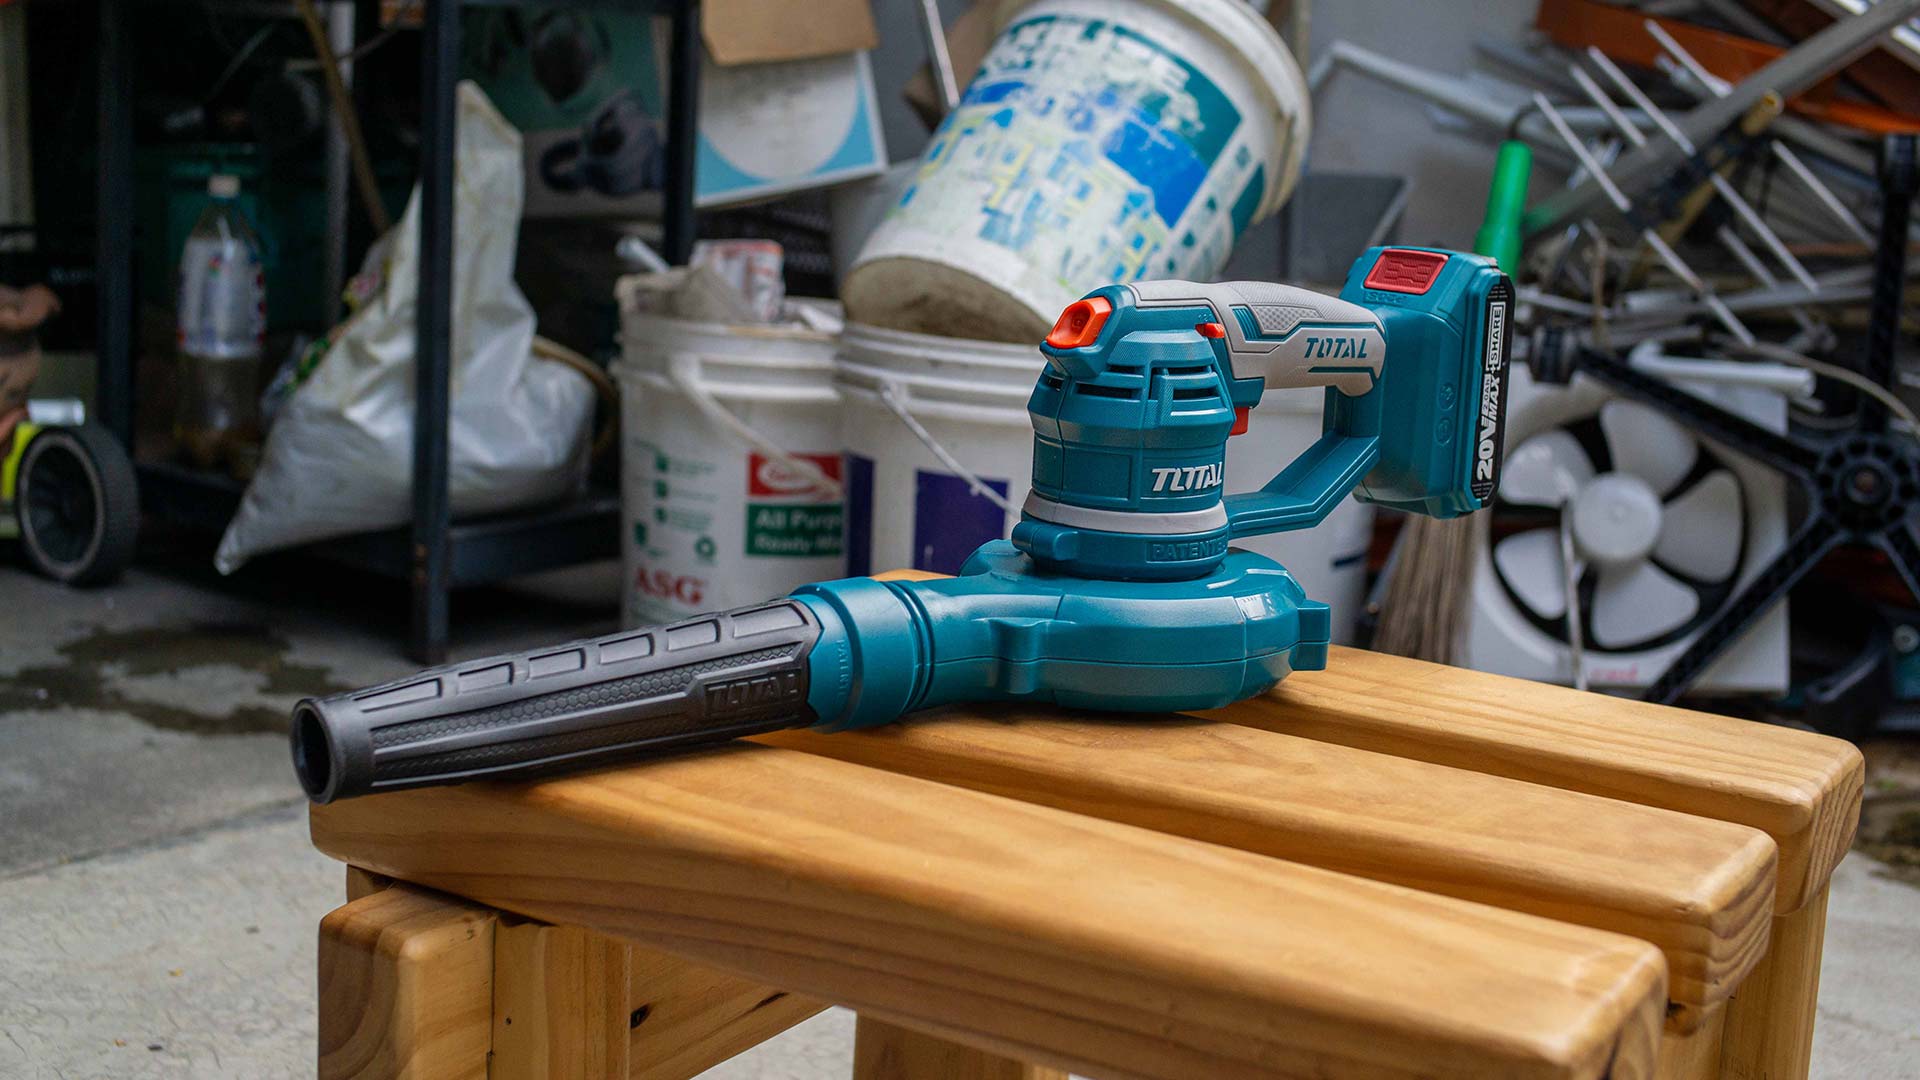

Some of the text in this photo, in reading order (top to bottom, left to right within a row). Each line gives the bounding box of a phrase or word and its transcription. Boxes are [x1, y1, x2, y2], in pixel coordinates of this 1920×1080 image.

[1304, 338, 1367, 358] TOTAL
[1477, 373, 1500, 480] 20V MAX
[1153, 462, 1222, 491] TOTAL
[635, 566, 704, 607] ASG
[707, 673, 799, 706] TOTAL
